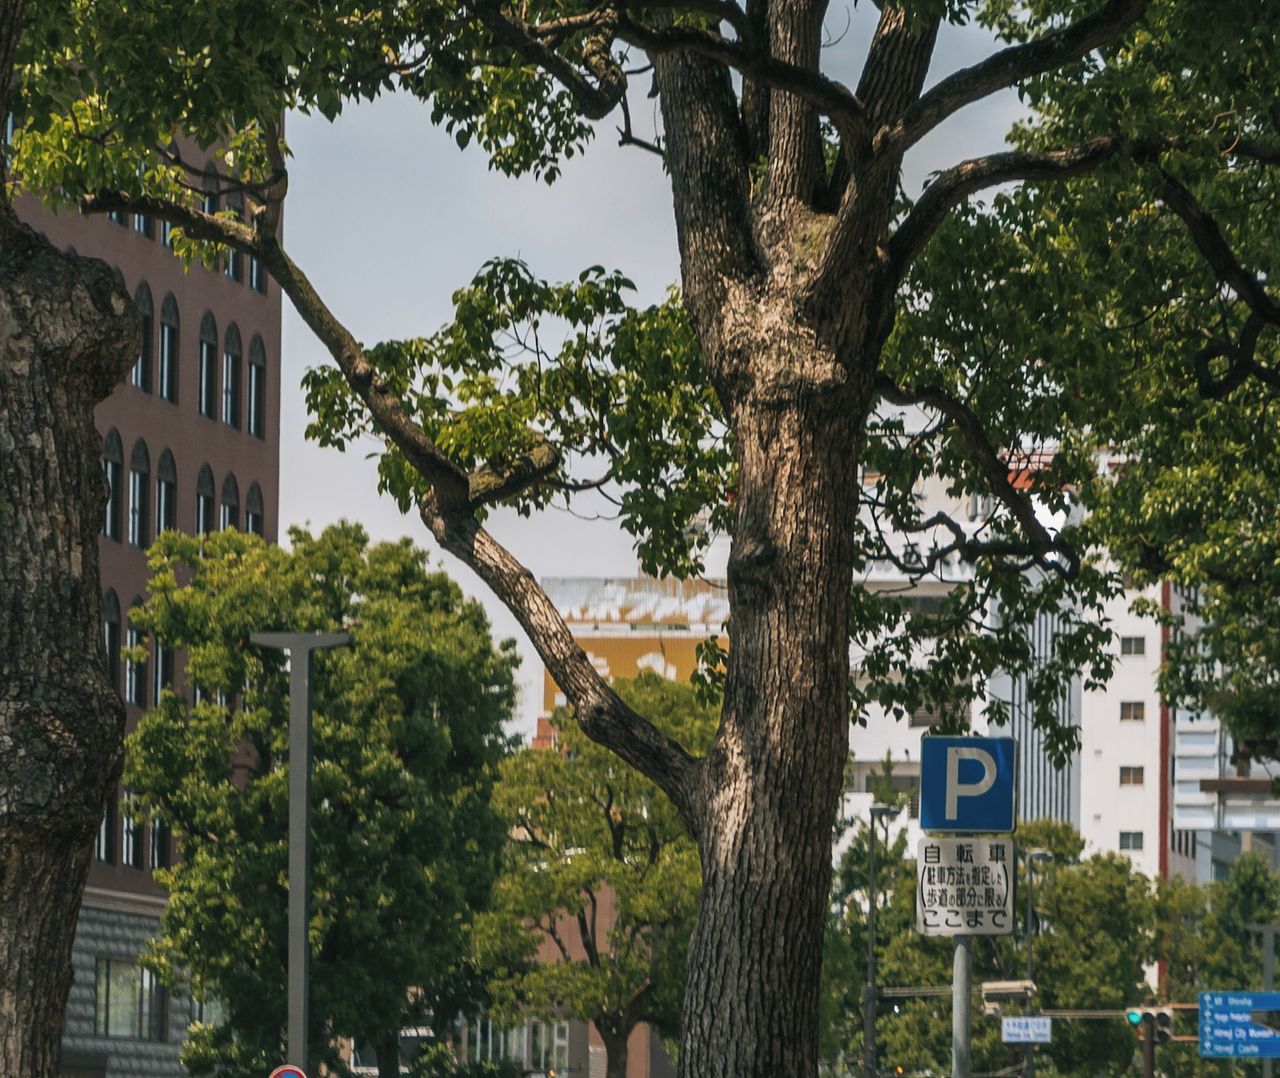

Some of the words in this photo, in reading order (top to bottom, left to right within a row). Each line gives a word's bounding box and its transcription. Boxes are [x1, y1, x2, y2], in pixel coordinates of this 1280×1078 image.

[945, 747, 998, 820] P
[924, 843, 1006, 864] 自転車
[923, 909, 1008, 928] ここまで
